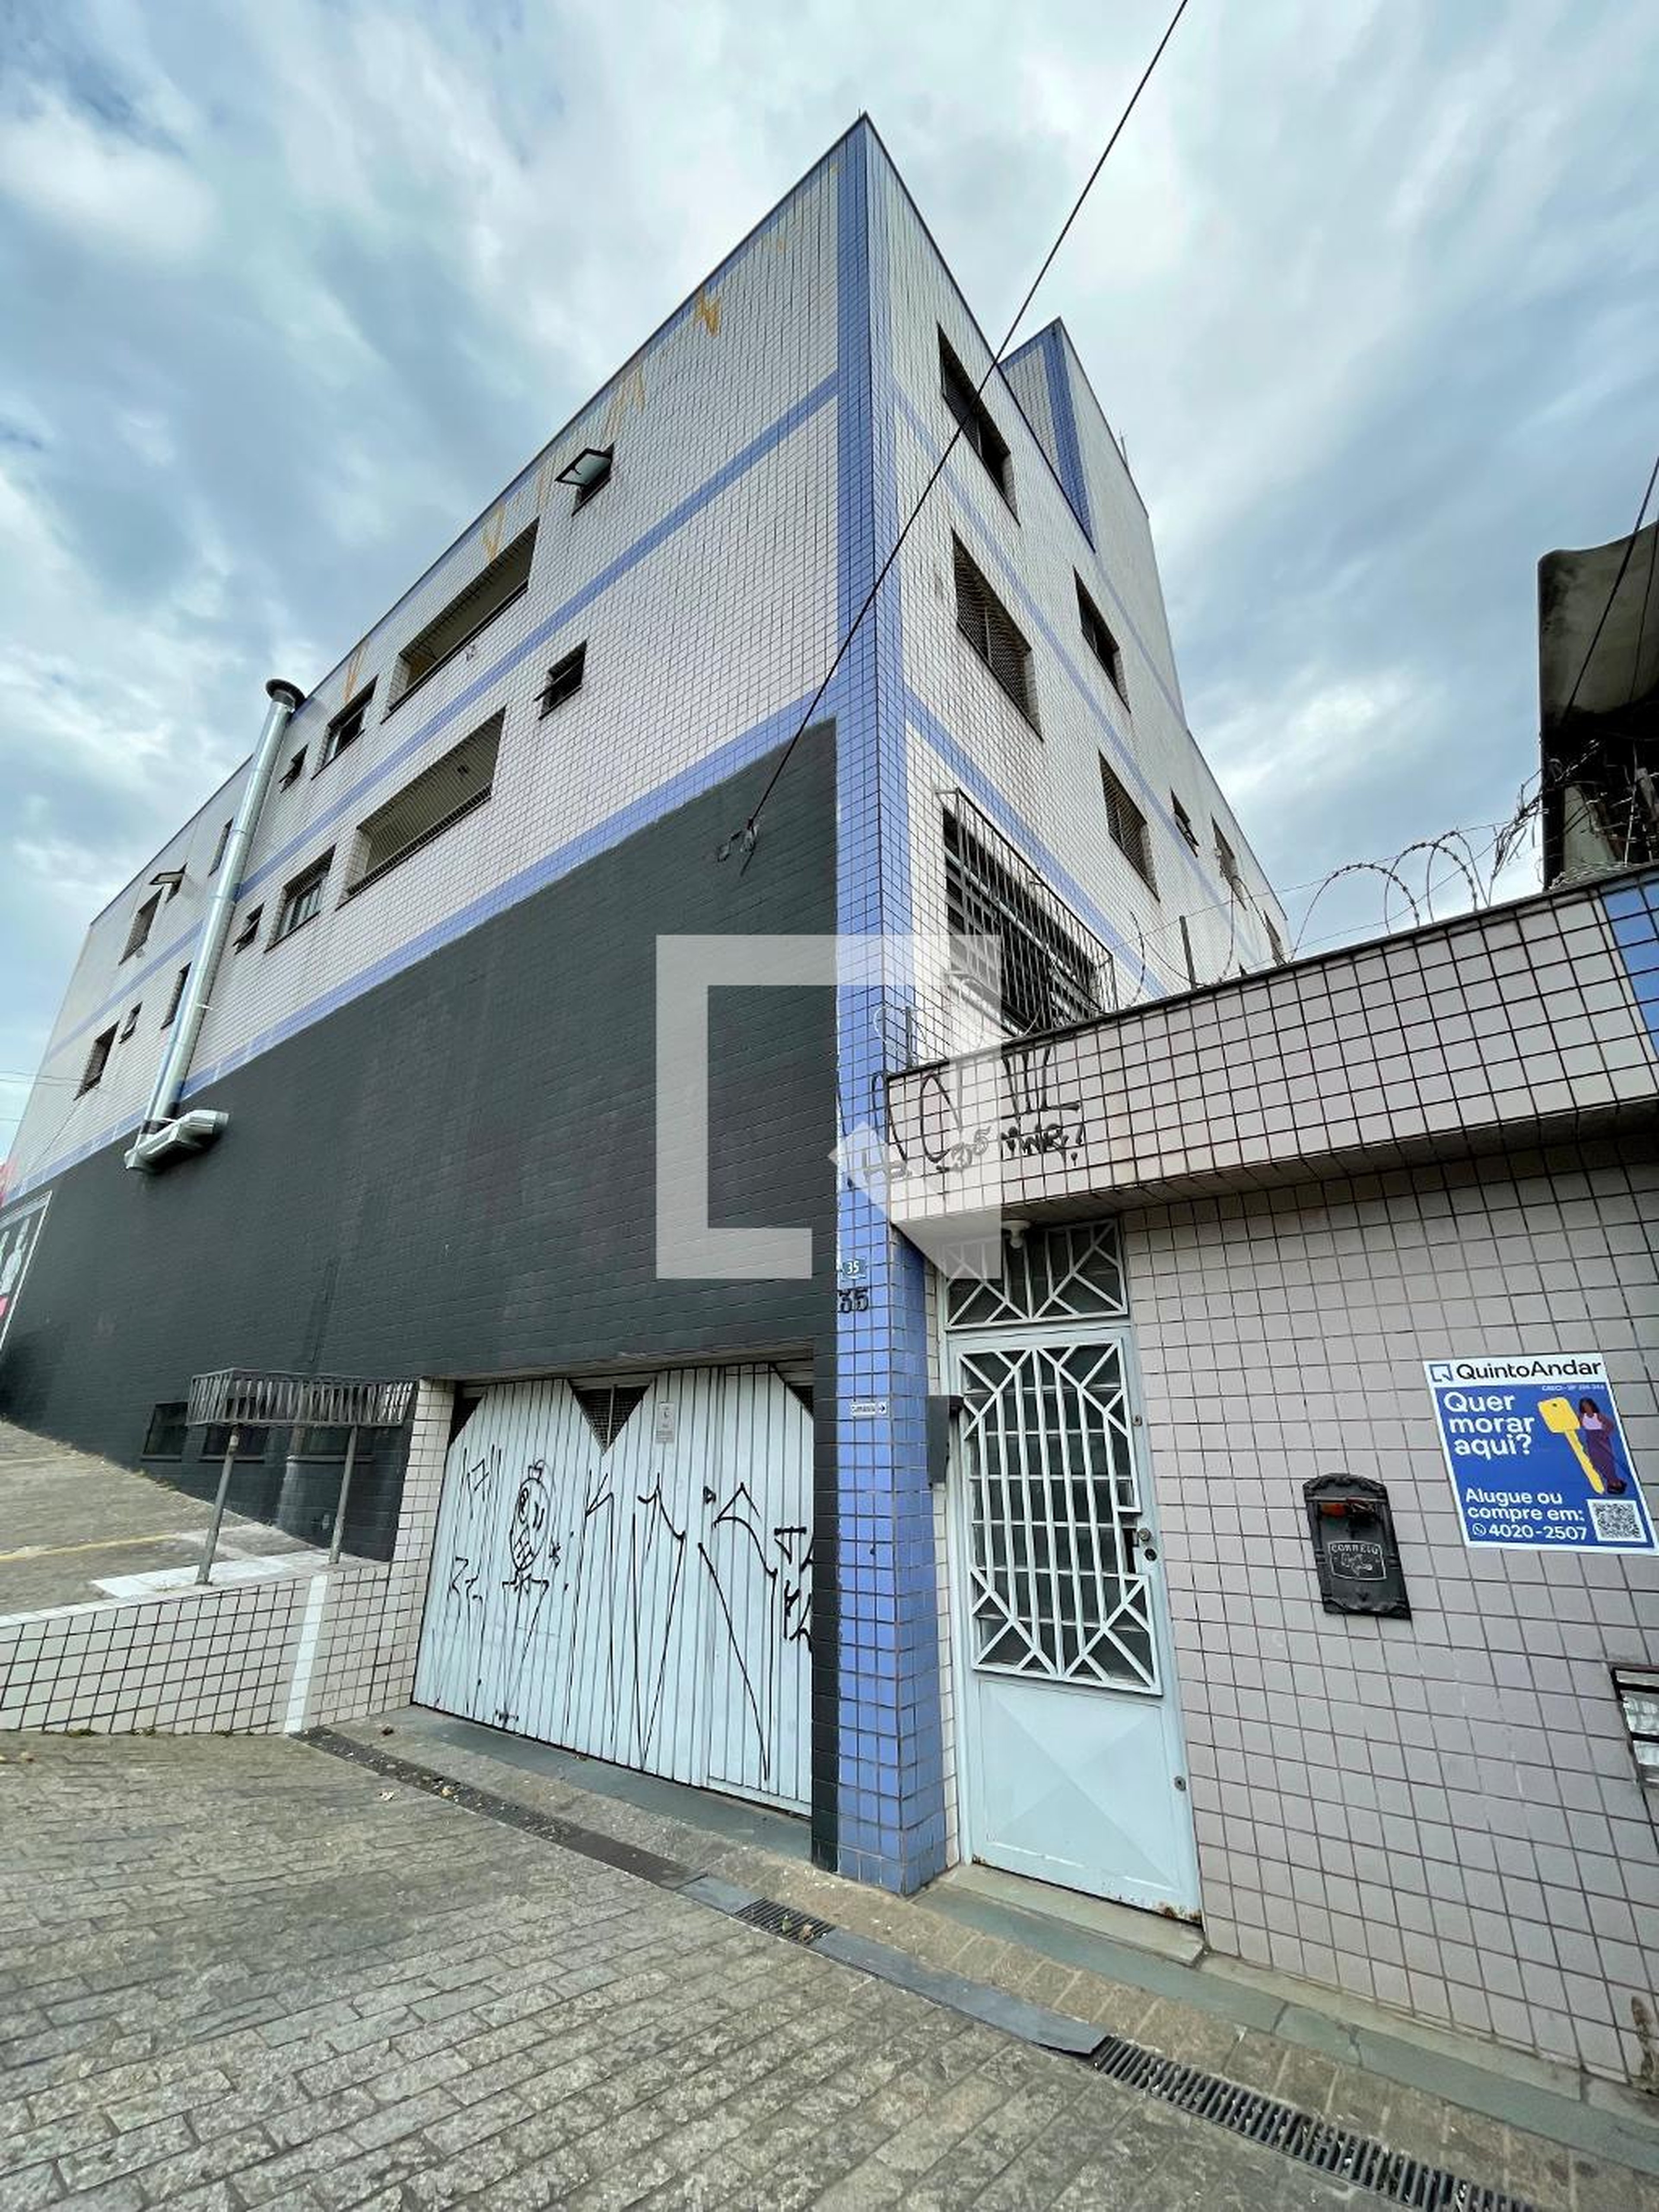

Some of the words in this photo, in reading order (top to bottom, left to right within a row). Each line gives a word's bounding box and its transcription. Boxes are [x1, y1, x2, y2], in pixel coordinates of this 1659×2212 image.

[847, 1260, 859, 1274] 35
[1456, 1359, 1601, 1380] QuintoAndar
[1443, 1391, 1516, 1412] Quer
[1449, 1416, 1535, 1434] morar
[1453, 1434, 1532, 1460] aqui?
[1466, 1488, 1533, 1507] Alugue
[1537, 1492, 1563, 1504] ou
[1468, 1507, 1543, 1522] compre
[1547, 1509, 1585, 1521] em:
[1489, 1524, 1587, 1540] 4020-2507
